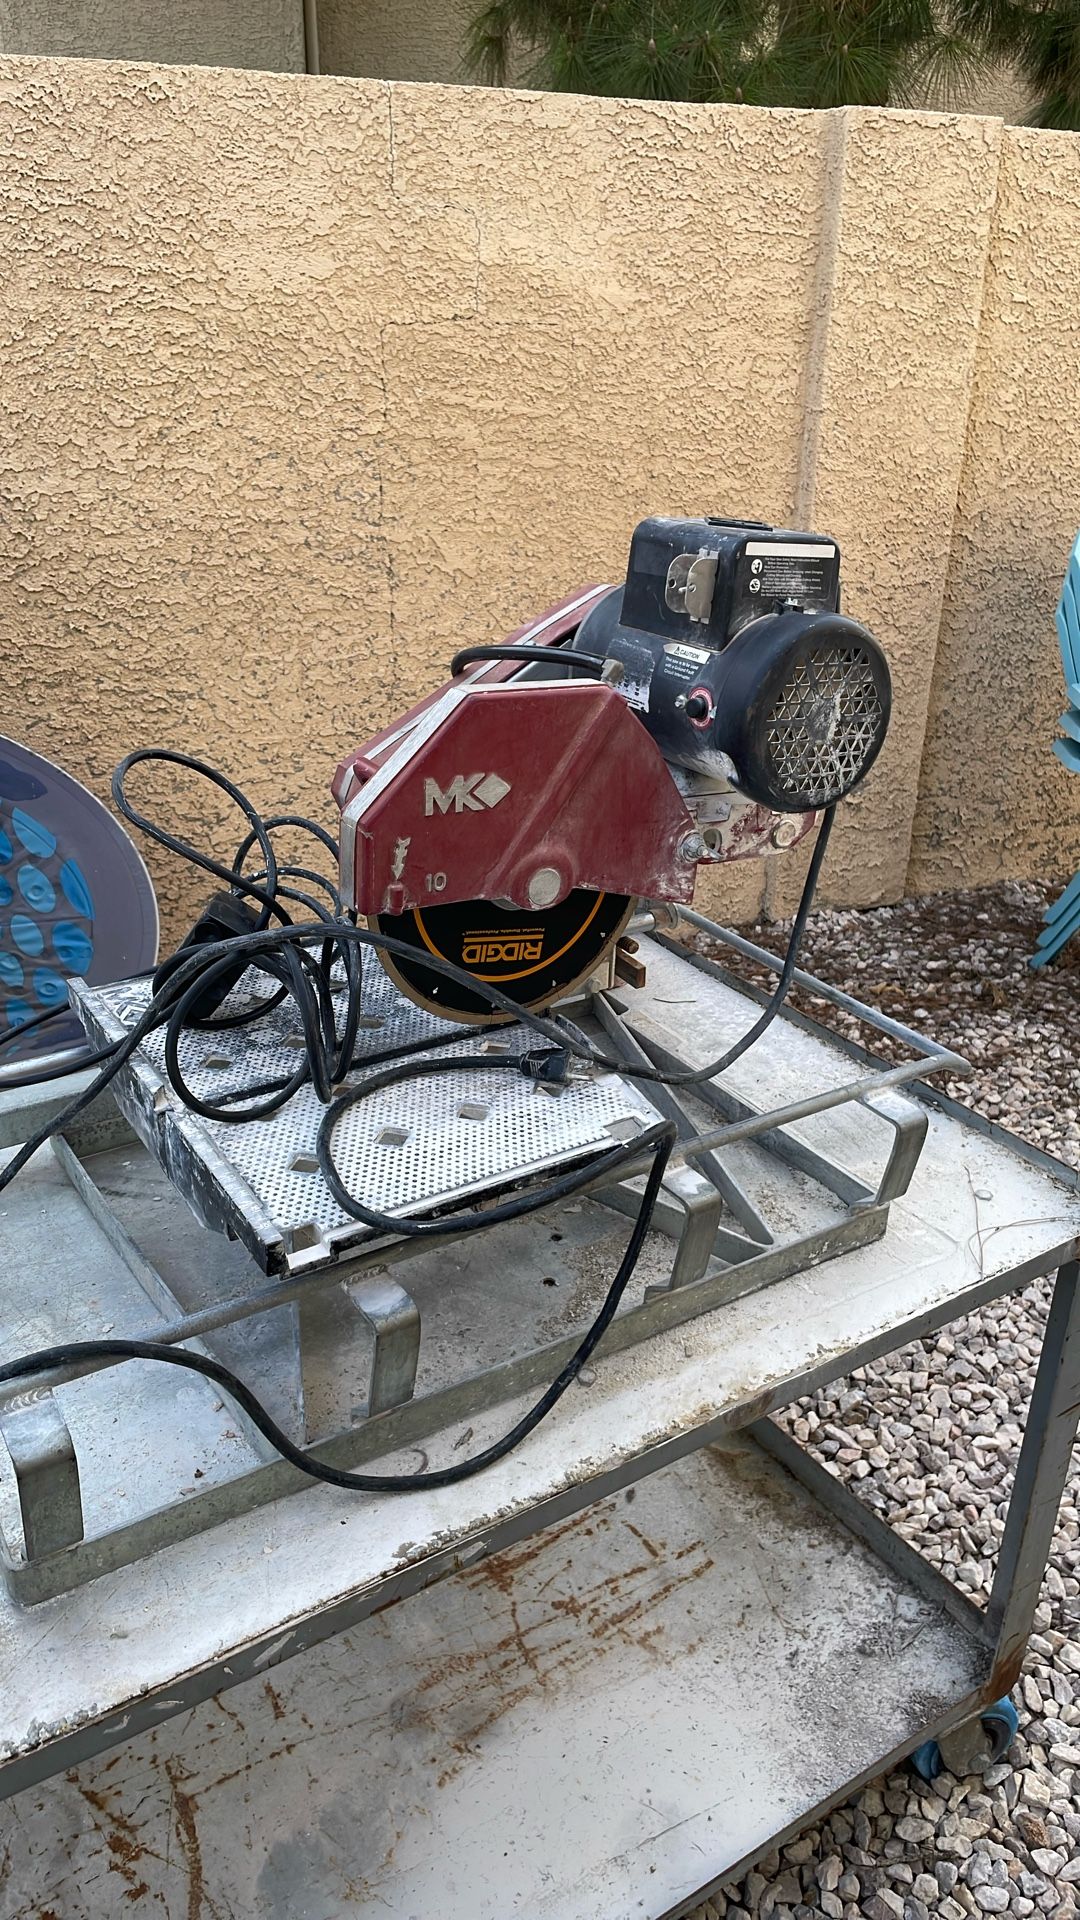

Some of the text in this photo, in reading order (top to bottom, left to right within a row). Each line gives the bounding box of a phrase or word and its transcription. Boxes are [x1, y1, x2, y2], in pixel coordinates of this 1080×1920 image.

[424, 772, 486, 817] MK
[425, 872, 447, 893] 10
[462, 941, 543, 963] RIDGID
